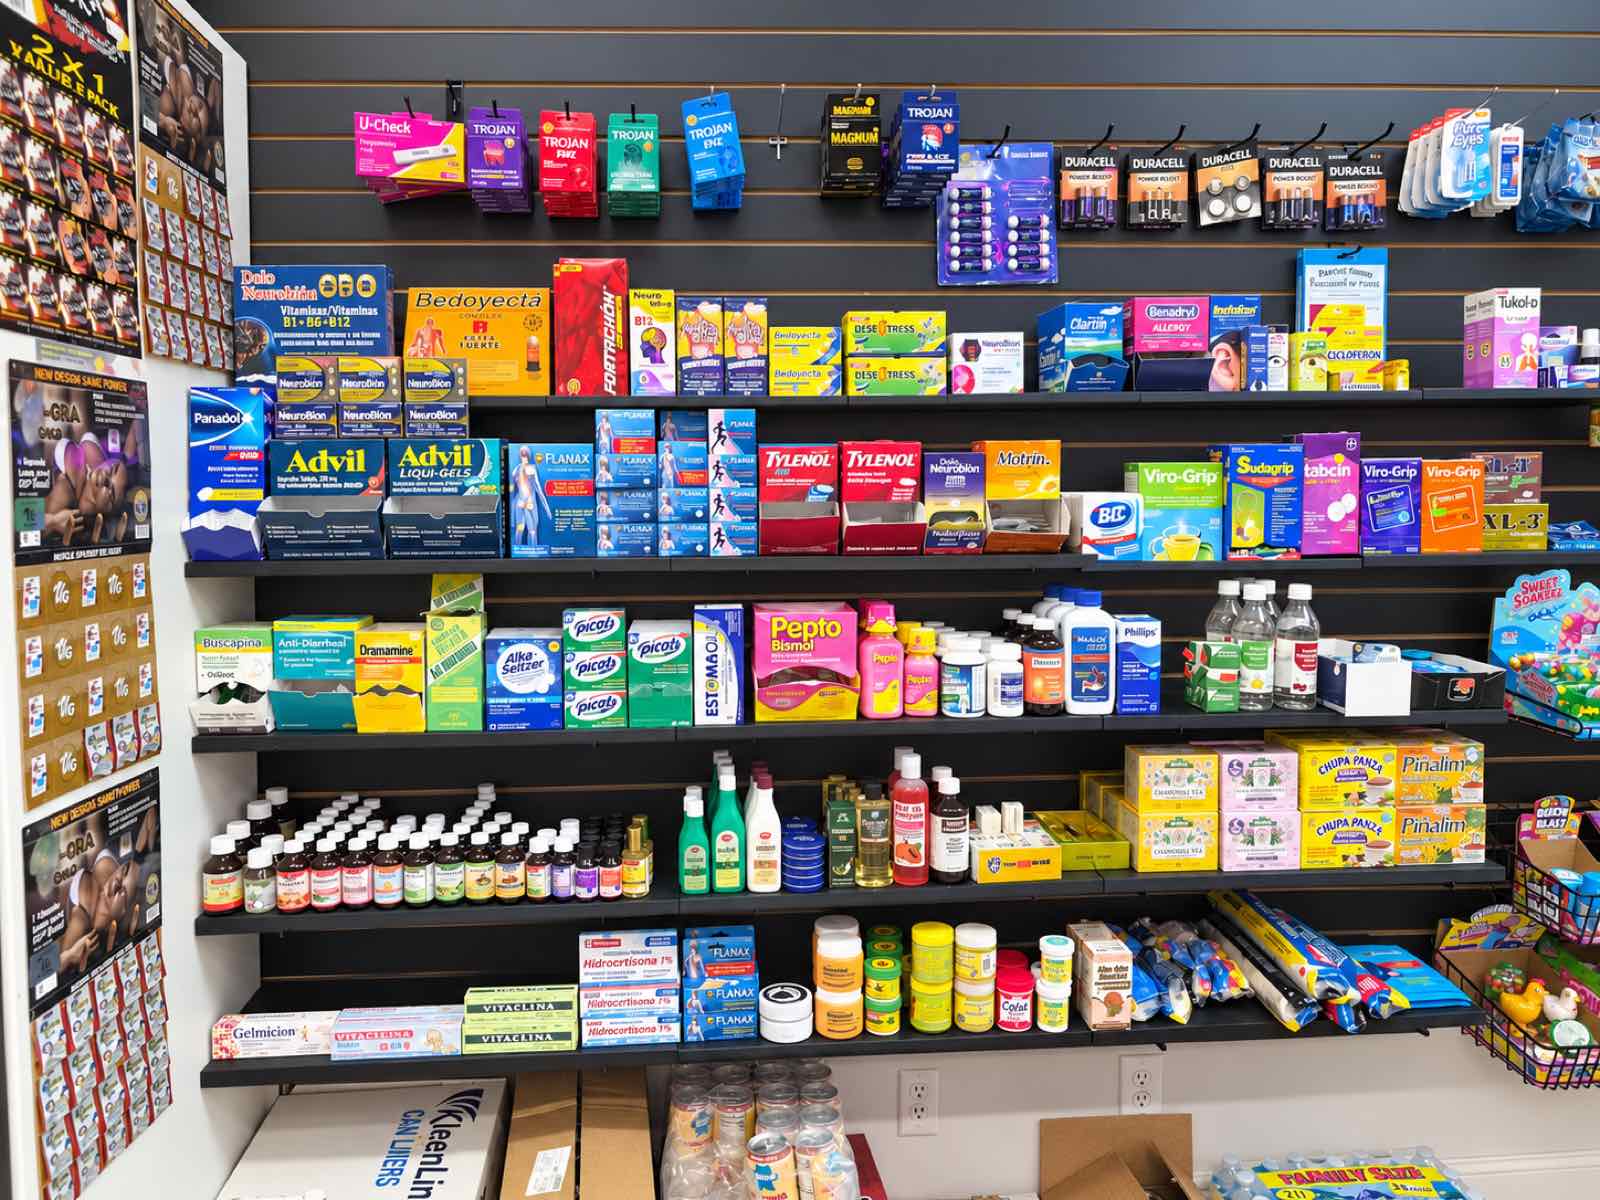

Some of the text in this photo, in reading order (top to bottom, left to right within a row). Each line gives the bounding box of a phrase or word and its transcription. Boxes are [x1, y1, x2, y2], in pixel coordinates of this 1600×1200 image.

[32, 34, 55, 64] 2
[93, 74, 104, 95] 1
[907, 108, 953, 118] TROJAN
[359, 116, 412, 134] U-Check
[473, 125, 516, 135] TROJAN
[689, 122, 733, 140] TROJAN
[611, 130, 654, 140] TROJAN
[831, 131, 879, 144] MAGNUM
[543, 136, 589, 149] TROJAN
[1065, 156, 1116, 168] DURACELL
[1133, 158, 1185, 169] DURACELL
[1202, 149, 1252, 167] DURACELL
[1269, 157, 1321, 169] DURACELL
[1329, 166, 1383, 177] DURACELL
[634, 316, 654, 326] B12
[194, 412, 241, 424] Panadol
[285, 449, 366, 472] Advil
[398, 443, 473, 467] Advil
[545, 452, 590, 464] FLANAX
[765, 451, 832, 468] TYLENOL
[847, 450, 916, 468] TYLENOL
[1236, 455, 1294, 475] Sudagrip
[1304, 464, 1352, 478] tabcin
[399, 467, 472, 480] LIQUI-GELS
[1144, 468, 1219, 486] Viro-Grip
[1364, 465, 1418, 480] Viro-Grip
[1426, 465, 1481, 480] Viro-Grip
[770, 616, 842, 642] Pepto
[203, 638, 262, 650] Buscapina
[359, 644, 414, 656] Dramamine
[771, 640, 815, 652] Bismol
[502, 659, 545, 676] Seltzer
[1318, 757, 1351, 776] CHUPA
[1316, 817, 1350, 836] CHUPA
[712, 946, 751, 959] FLANAX
[715, 988, 755, 998] FLANAX
[482, 1002, 555, 1012] VITACLINA
[715, 1015, 755, 1025] FLANAX
[232, 1026, 296, 1040] Gelmicion
[481, 1034, 553, 1043] VITACLINA
[395, 1109, 425, 1135] CAN
[1278, 1168, 1368, 1185] FAMILY
